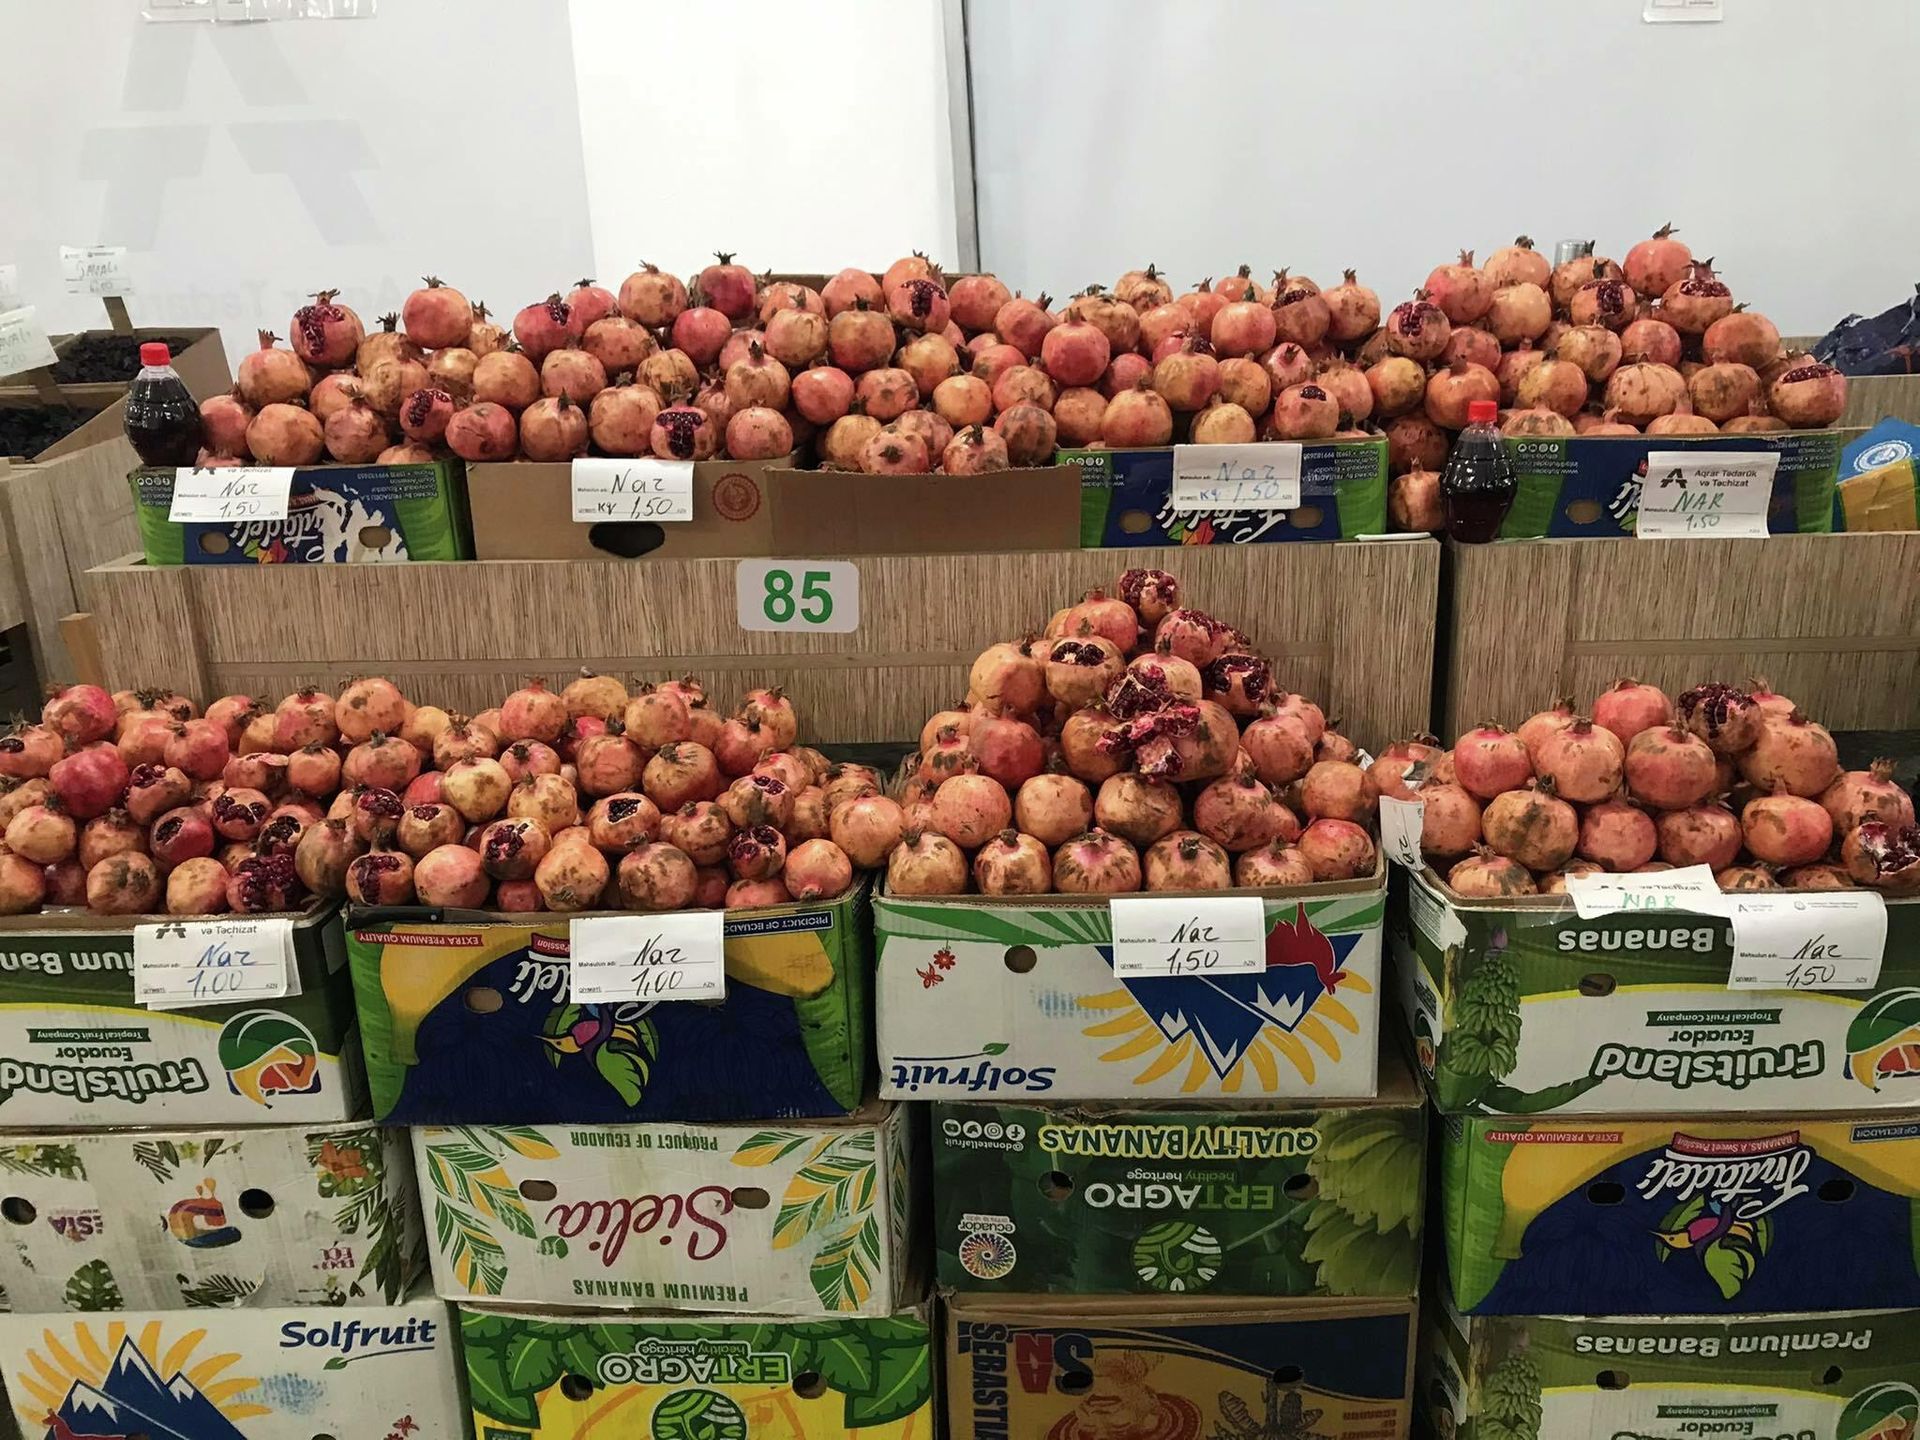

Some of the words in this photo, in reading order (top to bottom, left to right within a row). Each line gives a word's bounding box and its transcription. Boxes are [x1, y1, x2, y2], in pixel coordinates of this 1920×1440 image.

[630, 496, 673, 519] 1,50
[1674, 490, 1724, 513] NAR
[762, 569, 833, 624] 85
[724, 922, 764, 933] ECUADO
[765, 921, 780, 929] OF
[782, 916, 829, 928] PRODUCT
[358, 932, 398, 943] QUALITY
[399, 934, 446, 945] PREMIUM
[447, 935, 479, 945] EXTRA
[1558, 927, 1715, 953] Bananas
[536, 939, 570, 953] Passion
[1166, 947, 1220, 975] 1,50
[631, 967, 684, 997] 1,00
[1786, 963, 1836, 989] 1,50
[187, 970, 244, 999] 1,00
[1656, 1010, 1705, 1022] Company
[1705, 1013, 1731, 1023] Fruit
[1732, 1012, 1773, 1023] Tropical
[37, 1029, 81, 1040] Company
[81, 1031, 104, 1040] Fruit
[104, 1030, 143, 1040] Tropical
[1667, 1029, 1755, 1048] Ecuador
[55, 1046, 134, 1063] Ecuador
[1594, 1043, 1822, 1088] Fruitsland
[0, 1060, 206, 1102] Fruitsland
[890, 1061, 1057, 1092] Solfruit
[571, 1131, 630, 1147] ECUADOR
[636, 1133, 652, 1149] OF
[657, 1133, 718, 1151] PRODUCT
[944, 1137, 1024, 1152] @donatellafruit
[1041, 1128, 1185, 1156] BANANAS
[1193, 1129, 1319, 1156] QUALITY
[1490, 1132, 1534, 1141] QUALITY
[1536, 1133, 1584, 1142] PREMIUM
[1587, 1133, 1619, 1142] EXTRA
[1677, 1138, 1710, 1152] Passion
[1712, 1143, 1739, 1152] Sweet
[1741, 1143, 1747, 1152] A
[1126, 1168, 1183, 1182] heritage
[1183, 1169, 1236, 1182] healthy
[1636, 1150, 1811, 1219] Frutadeli
[1084, 1182, 1275, 1210] ERTAGRO
[545, 1186, 735, 1268] Sielia
[959, 1221, 1014, 1234] ecuador
[572, 1279, 655, 1299] BANANAS
[662, 1283, 749, 1303] PREMIUM
[279, 1317, 437, 1354] Solfruit
[1729, 1329, 1873, 1358] Premium
[639, 1343, 695, 1356] heritage
[699, 1343, 746, 1356] healthy
[1576, 1335, 1720, 1358] Bananas
[602, 1357, 786, 1382] ERTAGRO
[1676, 1421, 1754, 1437] Ecuador
